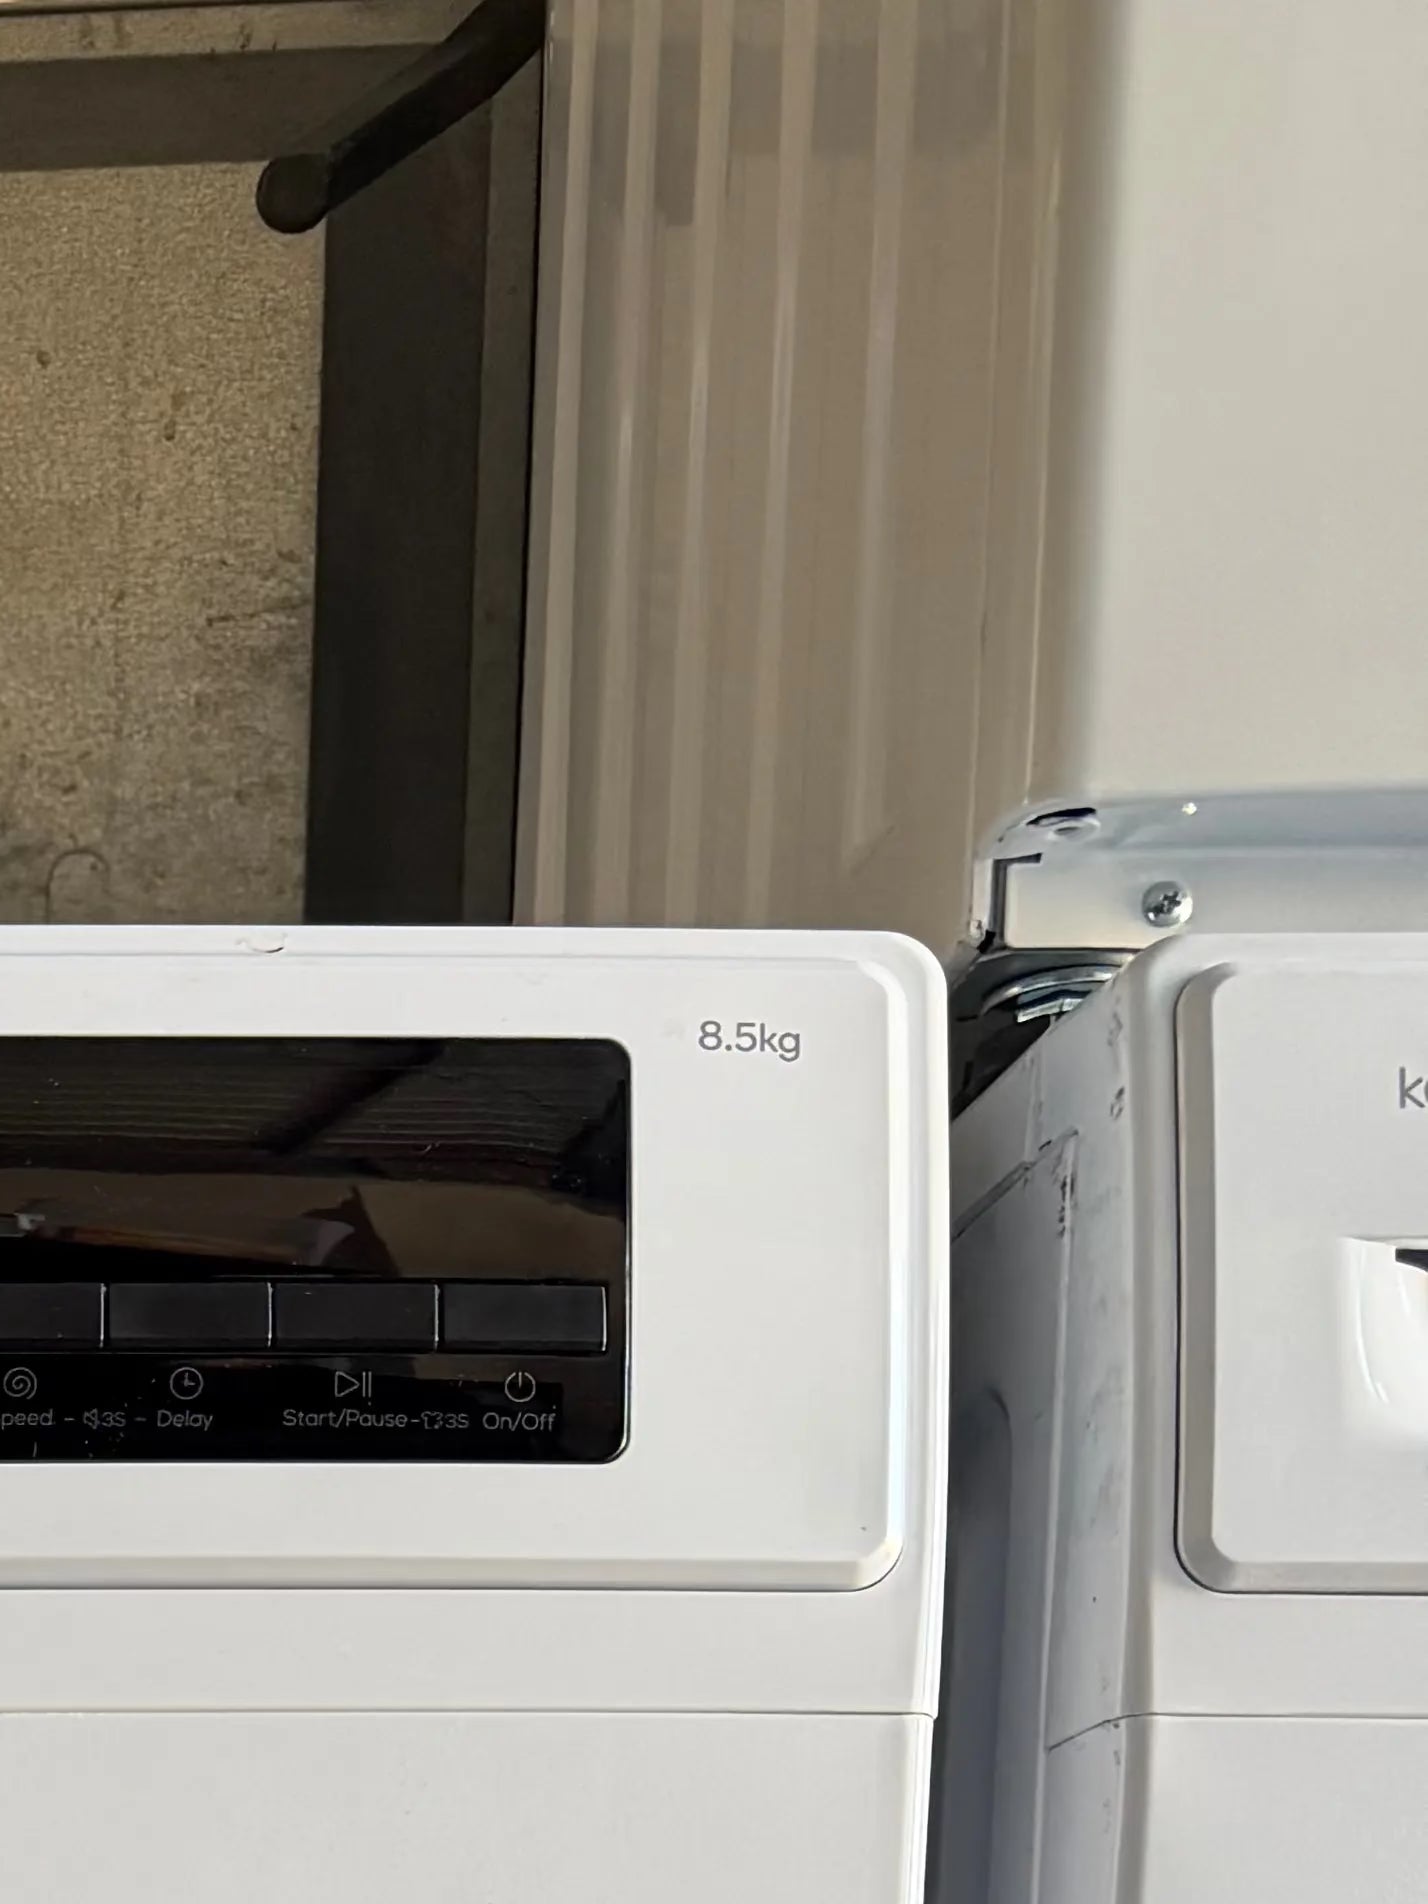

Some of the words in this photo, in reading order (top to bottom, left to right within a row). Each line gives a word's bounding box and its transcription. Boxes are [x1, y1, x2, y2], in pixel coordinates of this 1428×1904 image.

[698, 1020, 800, 1062] 8.5kg
[157, 1410, 213, 1431] Delay
[282, 1408, 407, 1428] Start/Pause
[482, 1412, 556, 1431] On/Off
